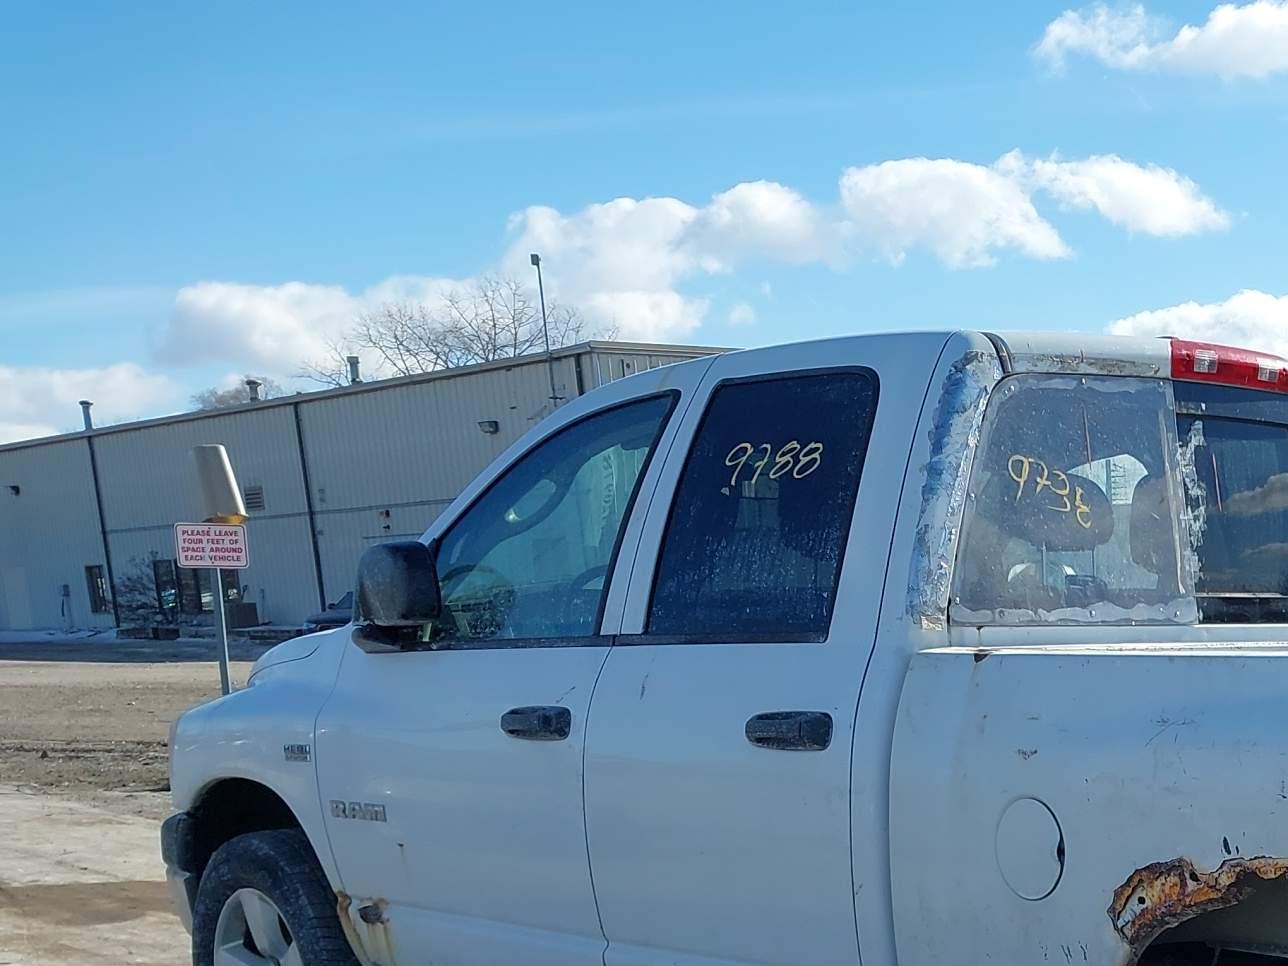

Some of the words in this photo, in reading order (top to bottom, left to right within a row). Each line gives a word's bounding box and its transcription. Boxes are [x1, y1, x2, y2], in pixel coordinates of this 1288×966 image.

[725, 440, 824, 486] 9788
[182, 529, 211, 537] PLEASE
[329, 799, 388, 823] RAM
